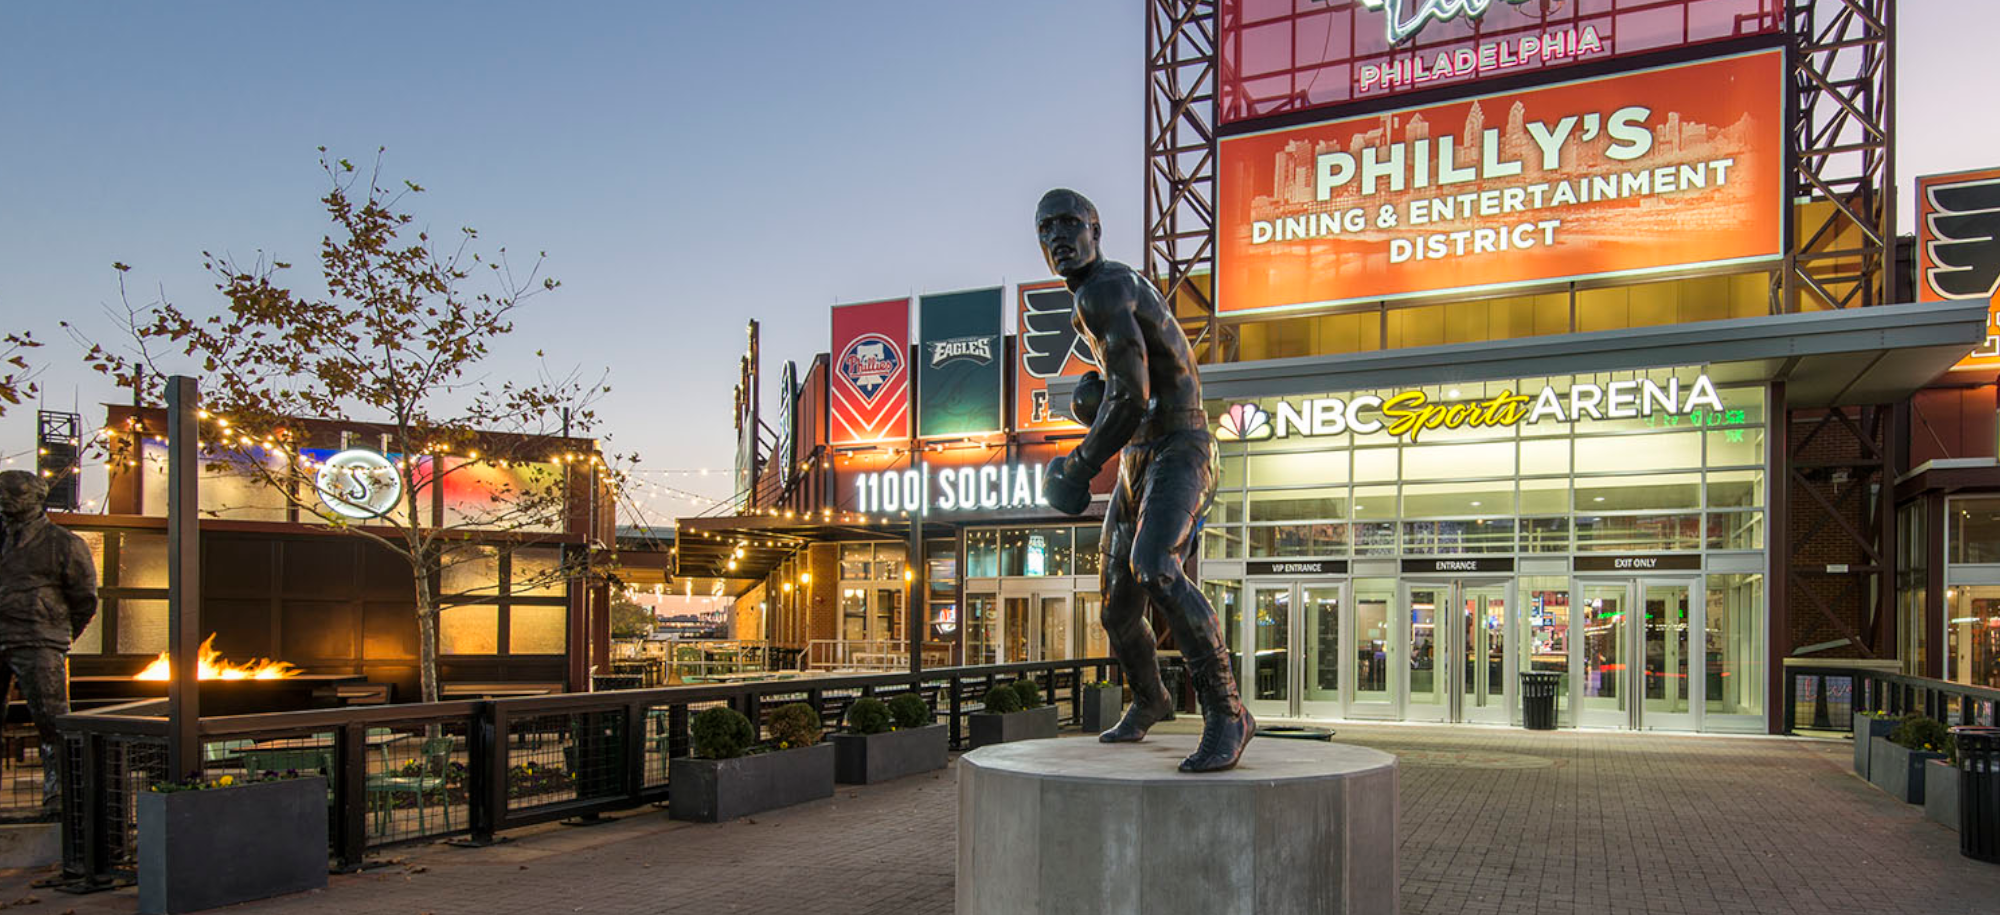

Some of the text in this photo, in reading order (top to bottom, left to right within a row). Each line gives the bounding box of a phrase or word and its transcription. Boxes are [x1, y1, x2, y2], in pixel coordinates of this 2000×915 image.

[1359, 25, 1602, 92] PHILADELPHIA
[1315, 106, 1654, 202] PHILLY'S
[1251, 157, 1735, 245] DINING & ENTERTAINMENT
[1389, 218, 1562, 264] DISTRICT
[846, 353, 893, 376] Phillies
[932, 337, 992, 365] EAGLES
[1276, 373, 1727, 444] NBC Sports ARENA
[938, 463, 1050, 510] SOCIAL
[1271, 563, 1322, 573] VIP ENTRANCE
[1435, 560, 1477, 571] ENTRANCE
[1614, 558, 1658, 568] EXIT ONLY
